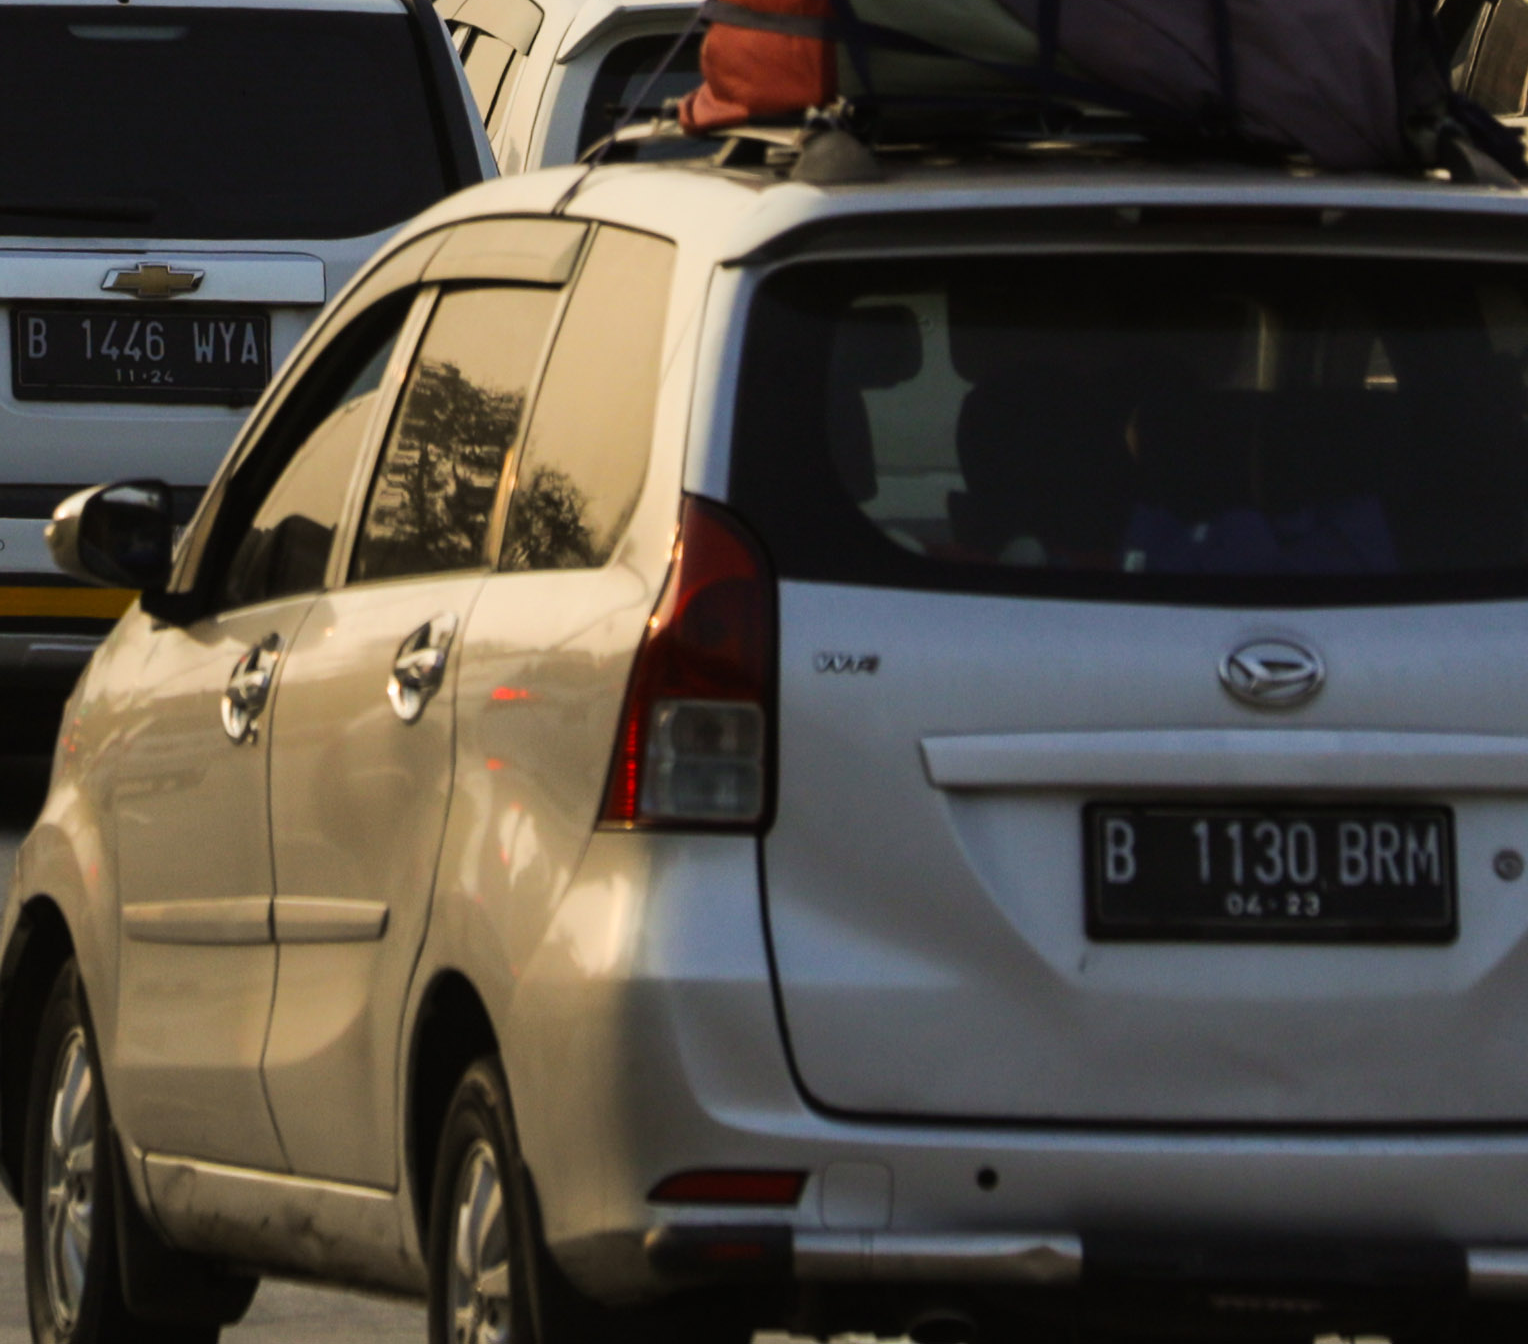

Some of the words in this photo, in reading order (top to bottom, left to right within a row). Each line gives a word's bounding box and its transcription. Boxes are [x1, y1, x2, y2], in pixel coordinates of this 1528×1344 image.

[27, 317, 48, 360] B
[82, 318, 166, 363] 1446
[192, 321, 261, 366] WYA
[1103, 820, 1136, 886] B
[1189, 819, 1318, 886] 1130
[1338, 818, 1442, 888] BRM
